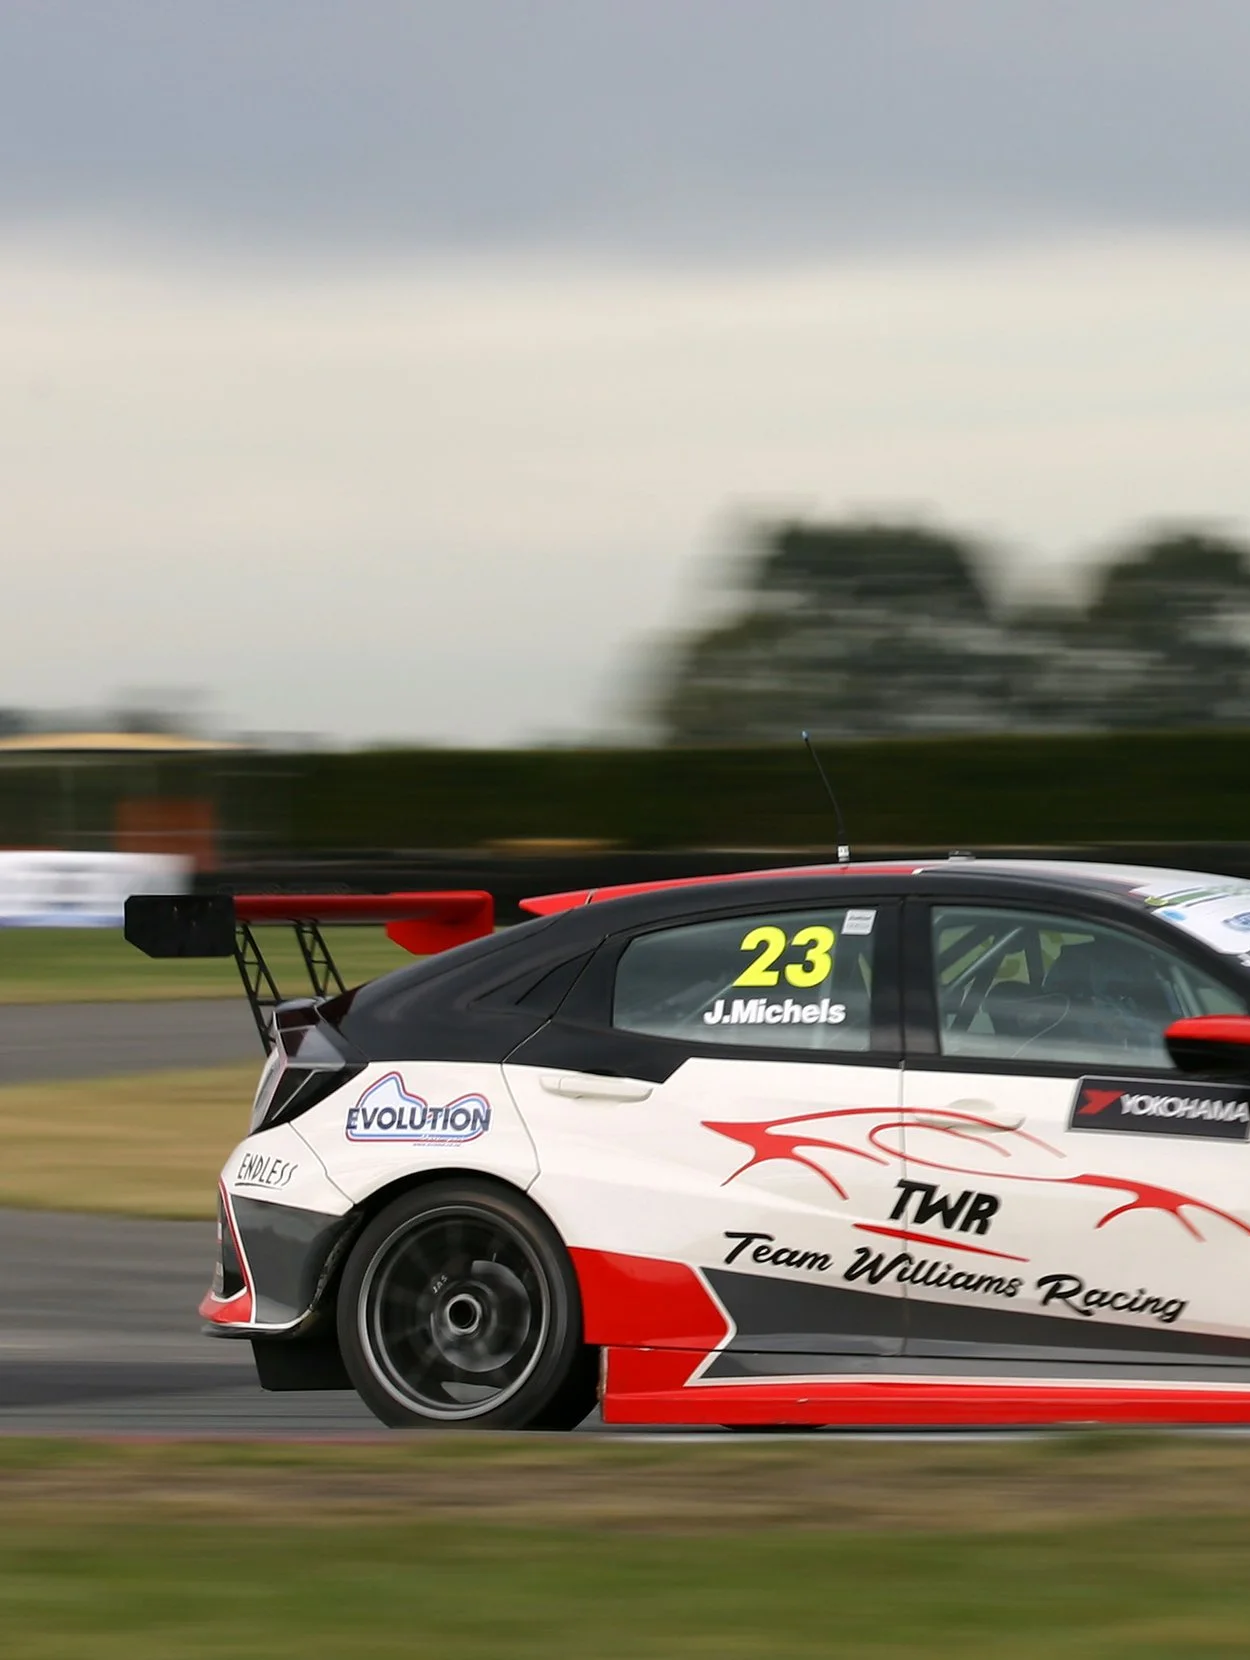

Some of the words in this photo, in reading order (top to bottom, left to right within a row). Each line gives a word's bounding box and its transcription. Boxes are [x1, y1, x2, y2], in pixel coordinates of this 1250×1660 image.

[732, 925, 835, 988] 23
[703, 998, 846, 1025] J.Michels
[346, 1107, 491, 1132] EVOLUTION
[1120, 1093, 1250, 1123] YOKOHAMA
[237, 1152, 298, 1187] ENDLESS
[889, 1178, 1002, 1235] TWR
[723, 1230, 834, 1273] Team
[843, 1246, 1025, 1298] Williams
[1036, 1273, 1188, 1323] Racing
